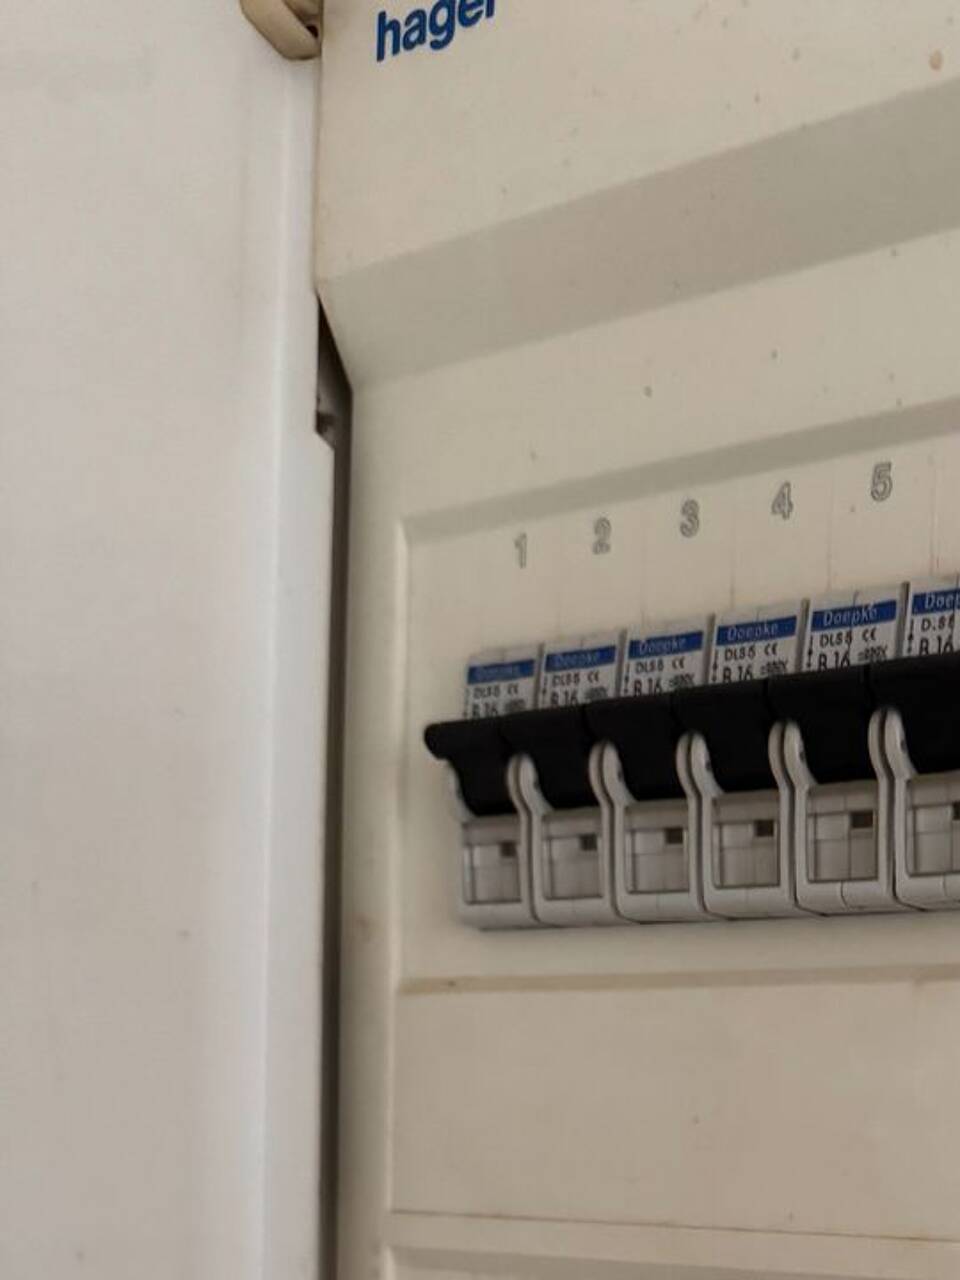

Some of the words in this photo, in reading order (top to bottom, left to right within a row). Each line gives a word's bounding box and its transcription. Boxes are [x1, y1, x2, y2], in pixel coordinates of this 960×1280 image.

[771, 481, 794, 520] 4
[870, 462, 893, 502] 5
[592, 516, 612, 555] 2
[680, 499, 699, 538] 3
[514, 532, 528, 569] 1
[823, 605, 877, 626] Doepke
[738, 663, 752, 681] 16
[834, 650, 850, 670] 16
